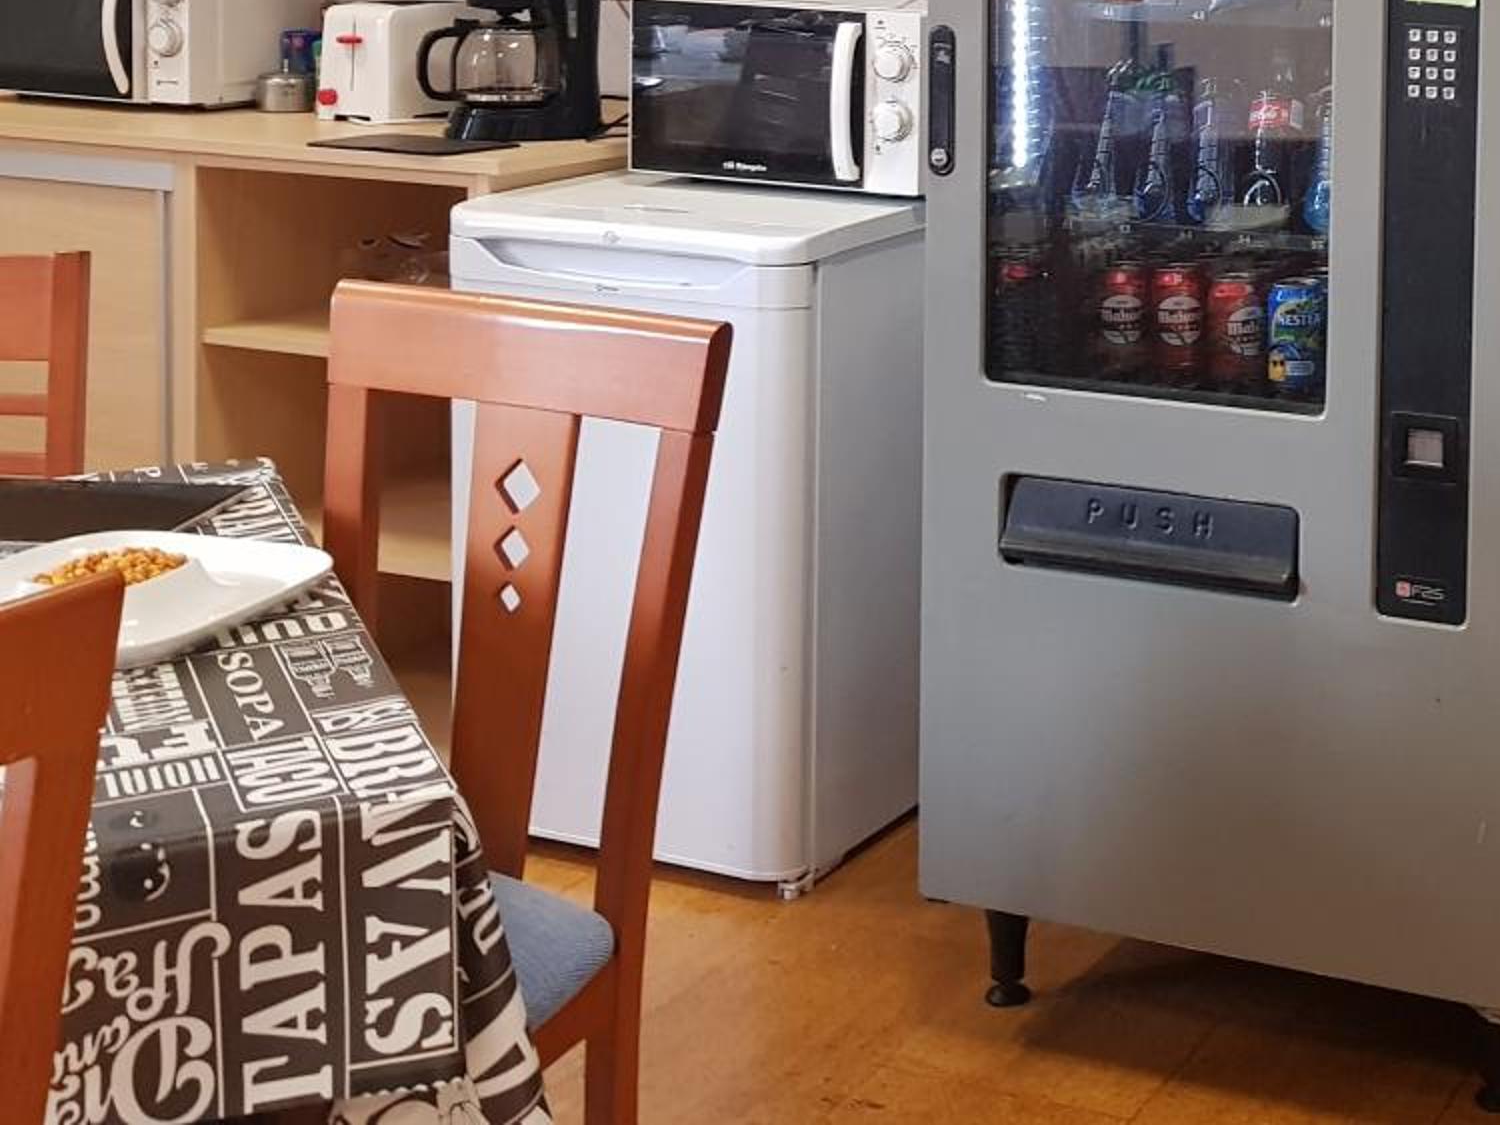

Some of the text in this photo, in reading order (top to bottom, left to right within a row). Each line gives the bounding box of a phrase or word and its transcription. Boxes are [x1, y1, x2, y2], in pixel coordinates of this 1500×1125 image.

[1085, 497, 1216, 541] PUSH
[217, 651, 285, 742] SOPA
[237, 808, 333, 1115] TAPAS
